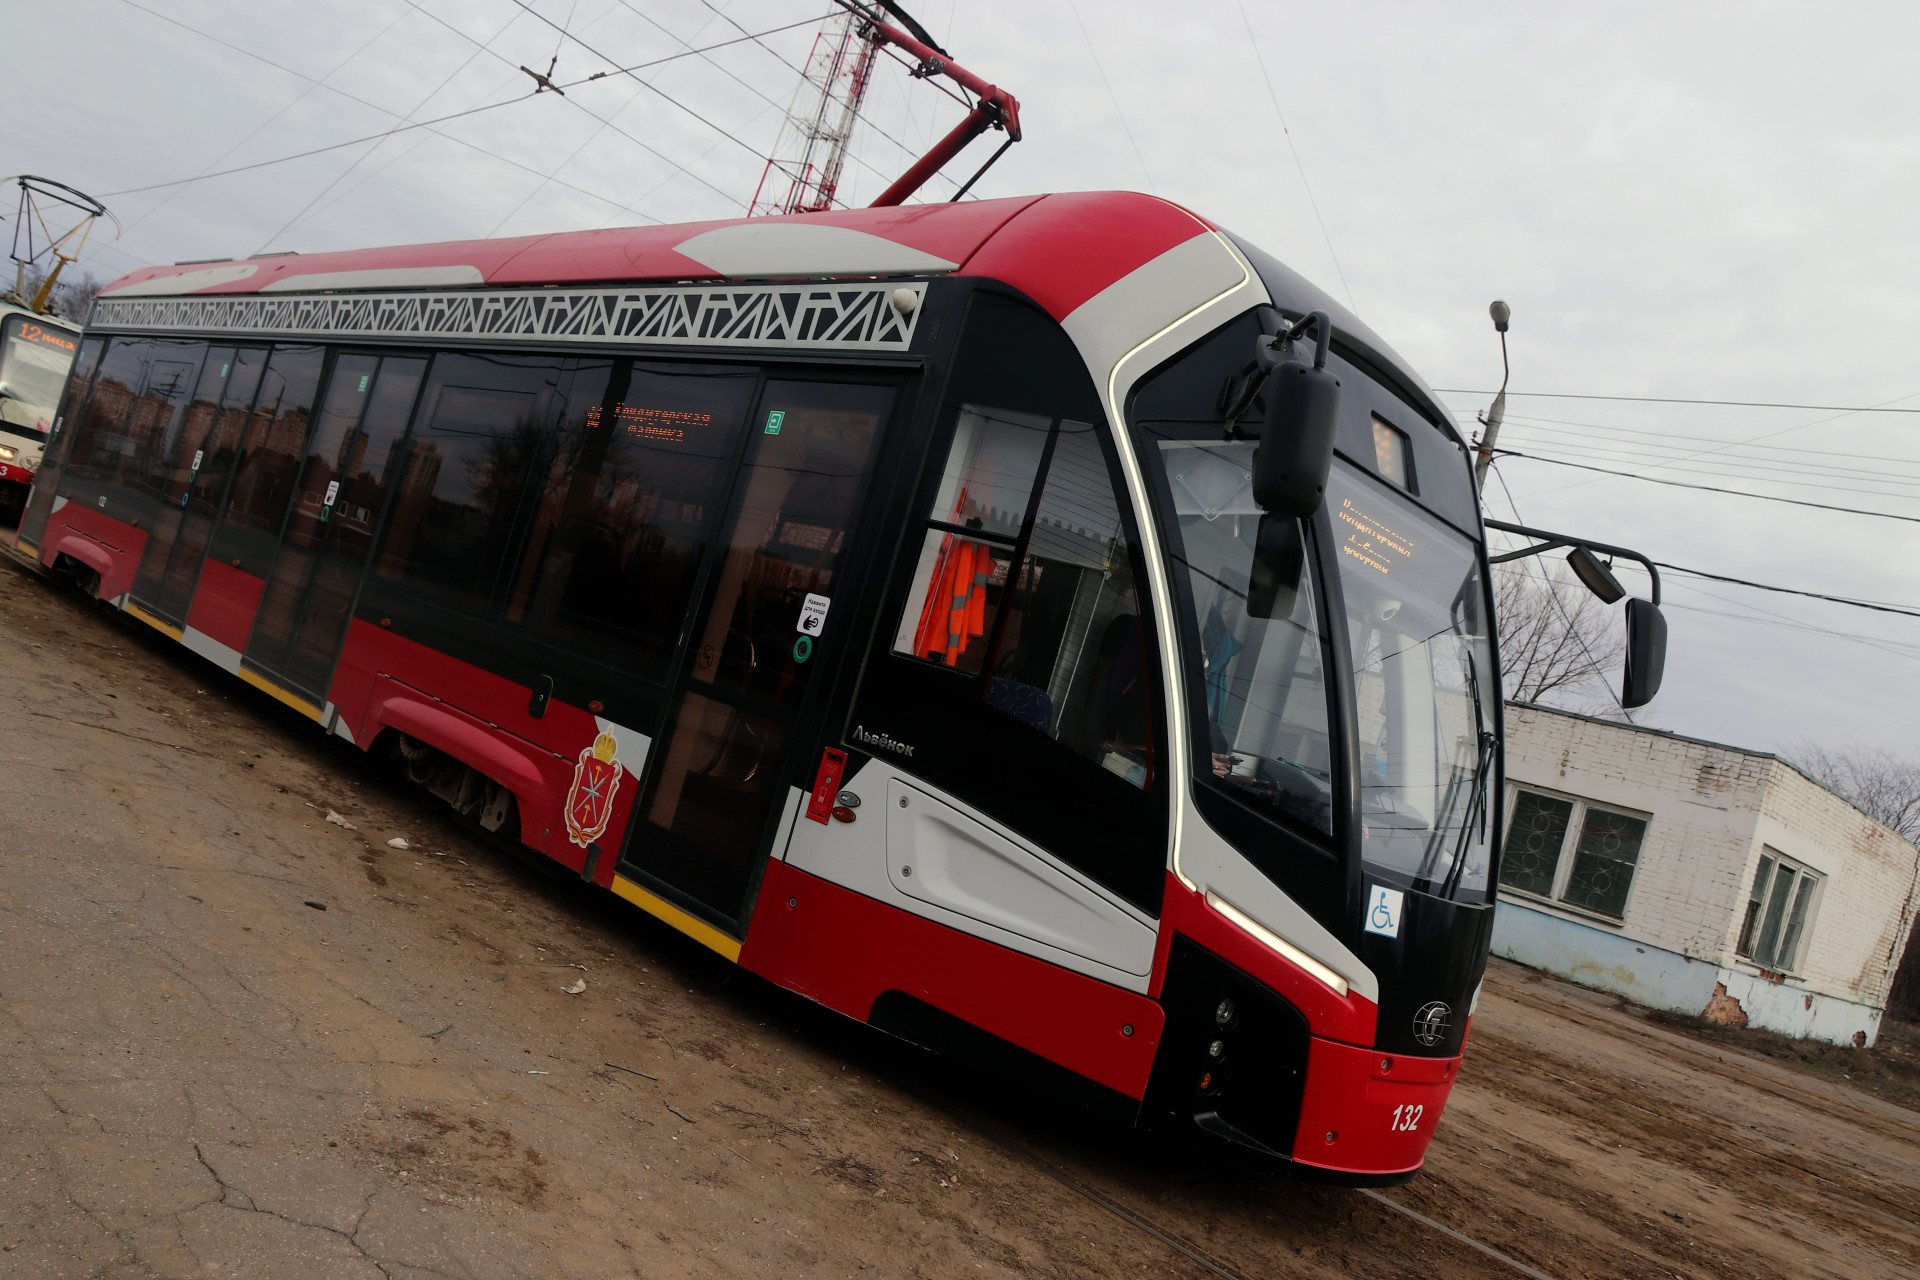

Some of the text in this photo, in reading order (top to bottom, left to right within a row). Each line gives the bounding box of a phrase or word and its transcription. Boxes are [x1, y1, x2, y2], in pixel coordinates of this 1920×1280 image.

[19, 322, 43, 343] 12
[852, 724, 915, 758] Львёнок
[1391, 1104, 1424, 1132] 132
